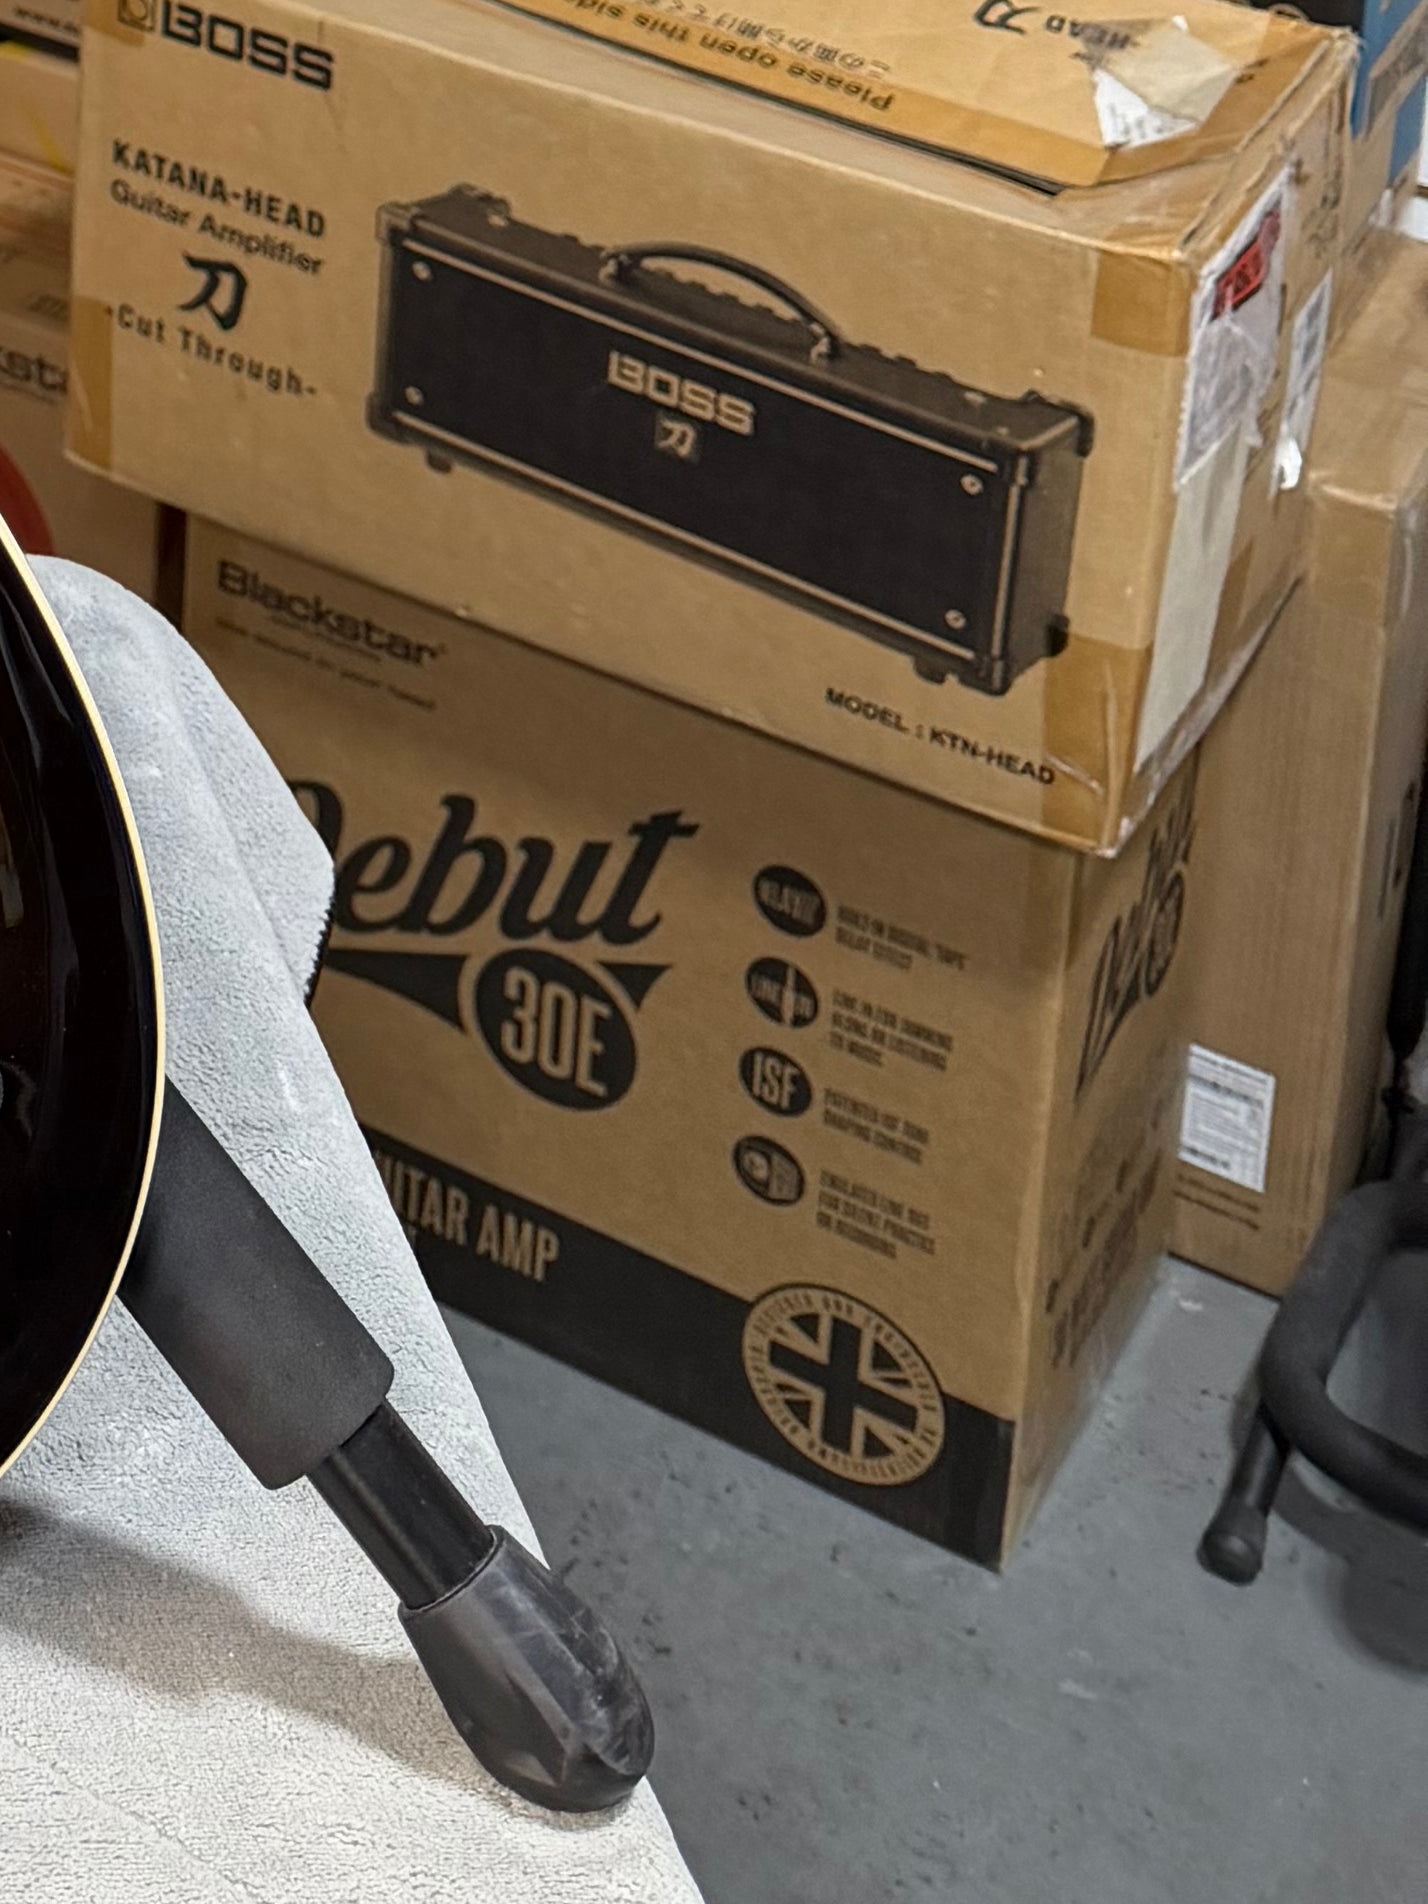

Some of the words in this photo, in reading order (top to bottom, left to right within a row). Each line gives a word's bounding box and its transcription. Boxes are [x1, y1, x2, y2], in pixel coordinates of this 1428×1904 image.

[631, 10, 692, 45] this
[697, 32, 779, 71] open
[785, 60, 897, 114] Please
[110, 177, 192, 228] Guitar
[198, 212, 323, 275] Amplifier
[111, 137, 326, 238] KATANA-HEAD
[177, 250, 248, 332] 刀
[607, 350, 757, 437] BOSS
[217, 559, 440, 667] Blackstar
[824, 686, 910, 735] MODEL
[929, 724, 1057, 786] KTN-HEAD
[501, 964, 611, 1098] 30E
[751, 1051, 800, 1110] ISF
[475, 1203, 560, 1284] AMP
